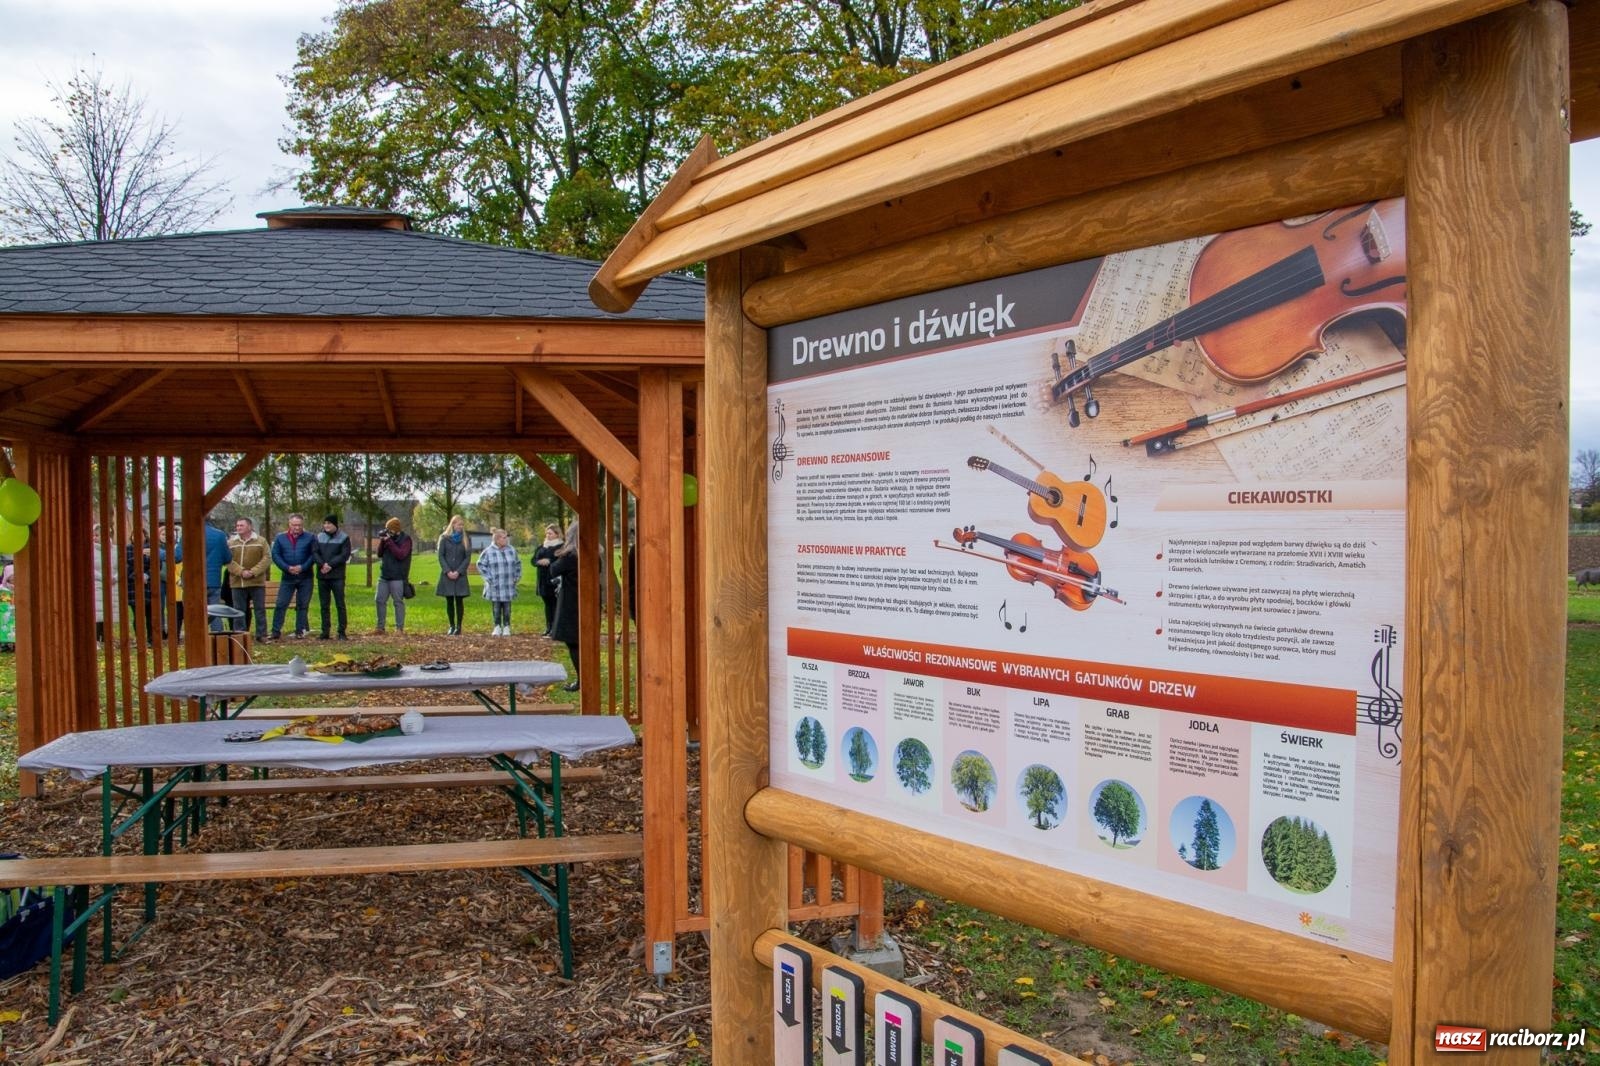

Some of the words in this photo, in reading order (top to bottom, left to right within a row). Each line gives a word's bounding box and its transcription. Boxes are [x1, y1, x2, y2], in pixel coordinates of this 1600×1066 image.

[791, 327, 886, 366] Drewno
[892, 315, 901, 348] i
[908, 293, 1017, 345] dźwięk
[796, 455, 829, 466] DREWNO
[830, 450, 890, 464] REZONANSOWE
[1227, 489, 1333, 504] CIEKAWOSTKI
[796, 543, 854, 555] ZASTOSOWANIE
[854, 545, 864, 555] W
[864, 545, 906, 557] PRAKTYCE
[800, 661, 819, 672] OLSZA
[862, 644, 922, 662] WŁAŚCIWOŚCI
[924, 652, 997, 673] REZONANSOWE
[1001, 661, 1070, 682] WYBRANYCH
[1074, 670, 1143, 691] GATUNKÓW
[1148, 679, 1196, 698] DRZEW
[847, 668, 870, 680] BRZOZA
[902, 677, 925, 688] JAWOR
[966, 686, 981, 697] BUK
[1032, 696, 1050, 708] LIPA
[1105, 707, 1130, 720] GRAB
[1188, 719, 1220, 734] JODŁA
[1280, 732, 1323, 749] ŚWIERK
